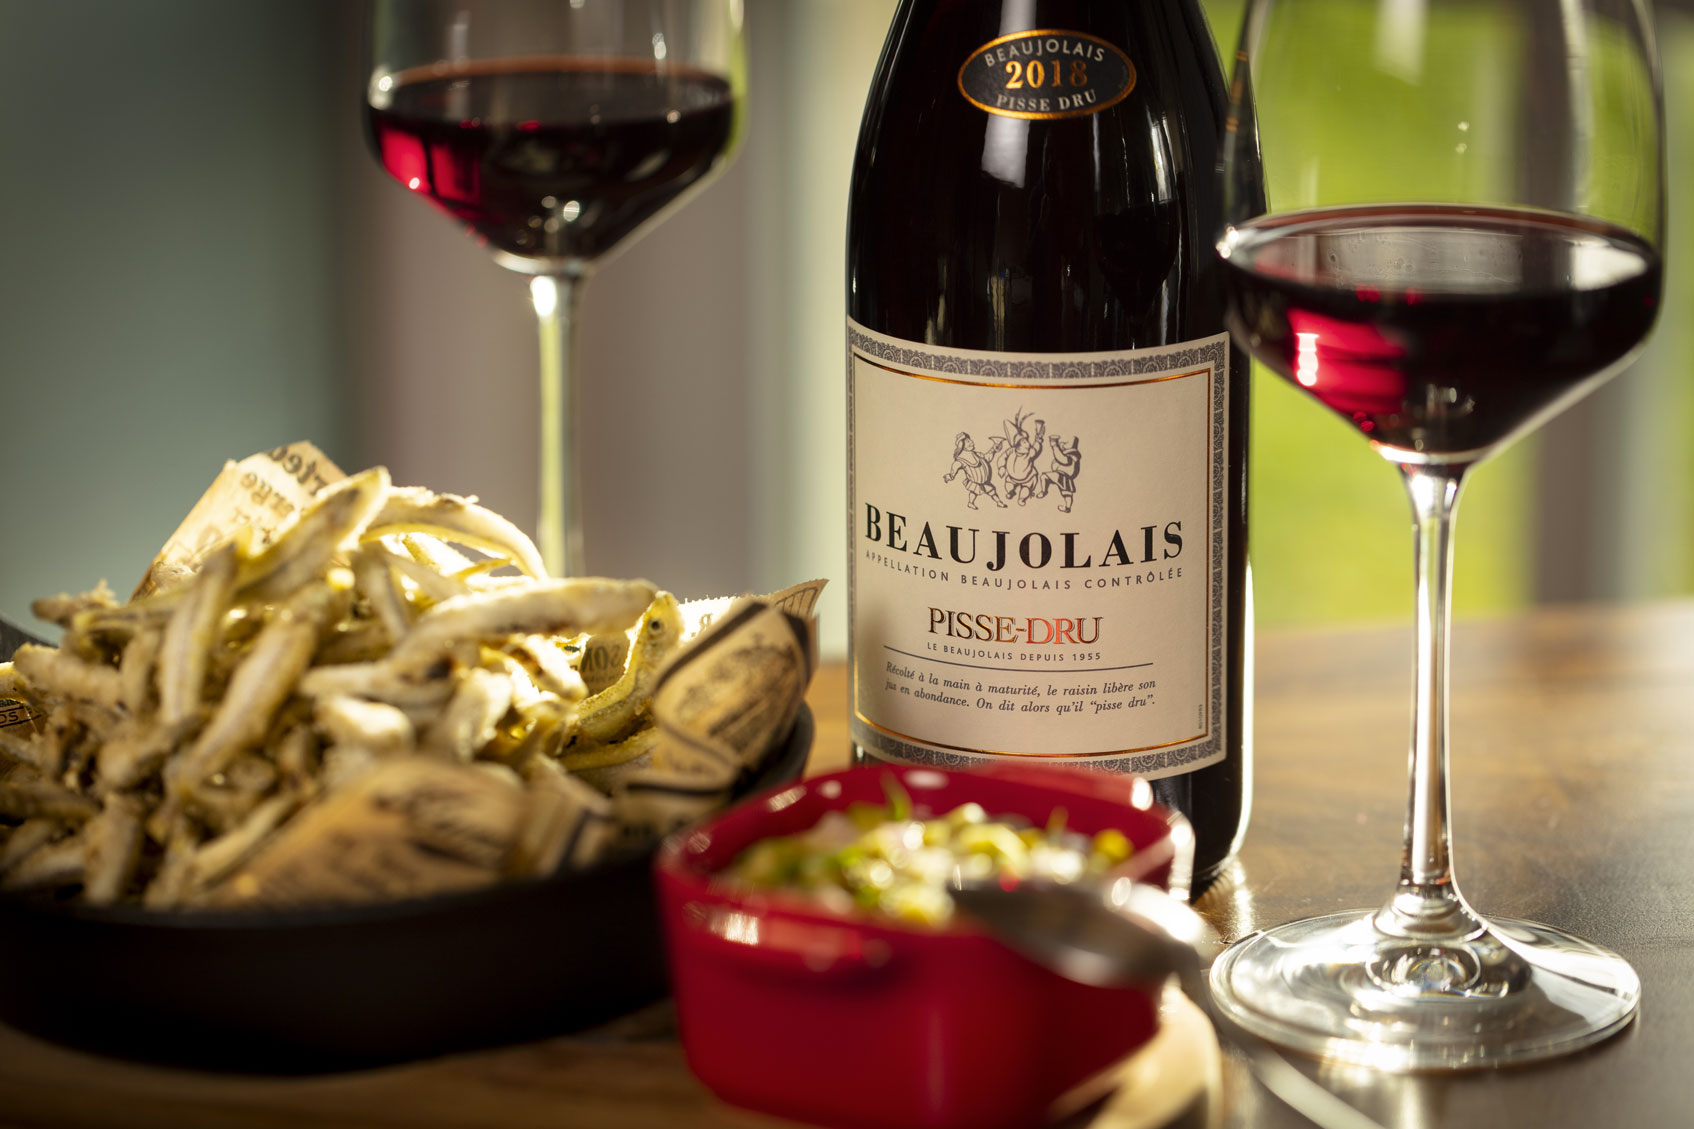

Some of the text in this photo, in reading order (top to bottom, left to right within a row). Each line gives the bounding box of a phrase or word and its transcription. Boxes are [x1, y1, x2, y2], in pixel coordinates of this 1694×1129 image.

[984, 39, 1105, 67] BEAUJOLAIS
[1005, 59, 1088, 90] 2018
[996, 89, 1097, 112] PISSE DRU
[864, 502, 1183, 572] BEAUJOLAIS
[865, 550, 1183, 590] APPELLATION BEAUJOLAIS CONTRÔLÉE
[928, 606, 1104, 645] PISSE-DRU
[927, 642, 1101, 662] LE BEAUJOLAIS DEPUIS 1955
[885, 679, 897, 692] jus
[900, 685, 910, 695] en
[914, 687, 970, 708] abondance.
[976, 697, 993, 710] On
[999, 699, 1015, 712] dit
[1021, 700, 1050, 713] alors
[886, 661, 1156, 698] Récolté à la main à maturité, le raisin libère son
